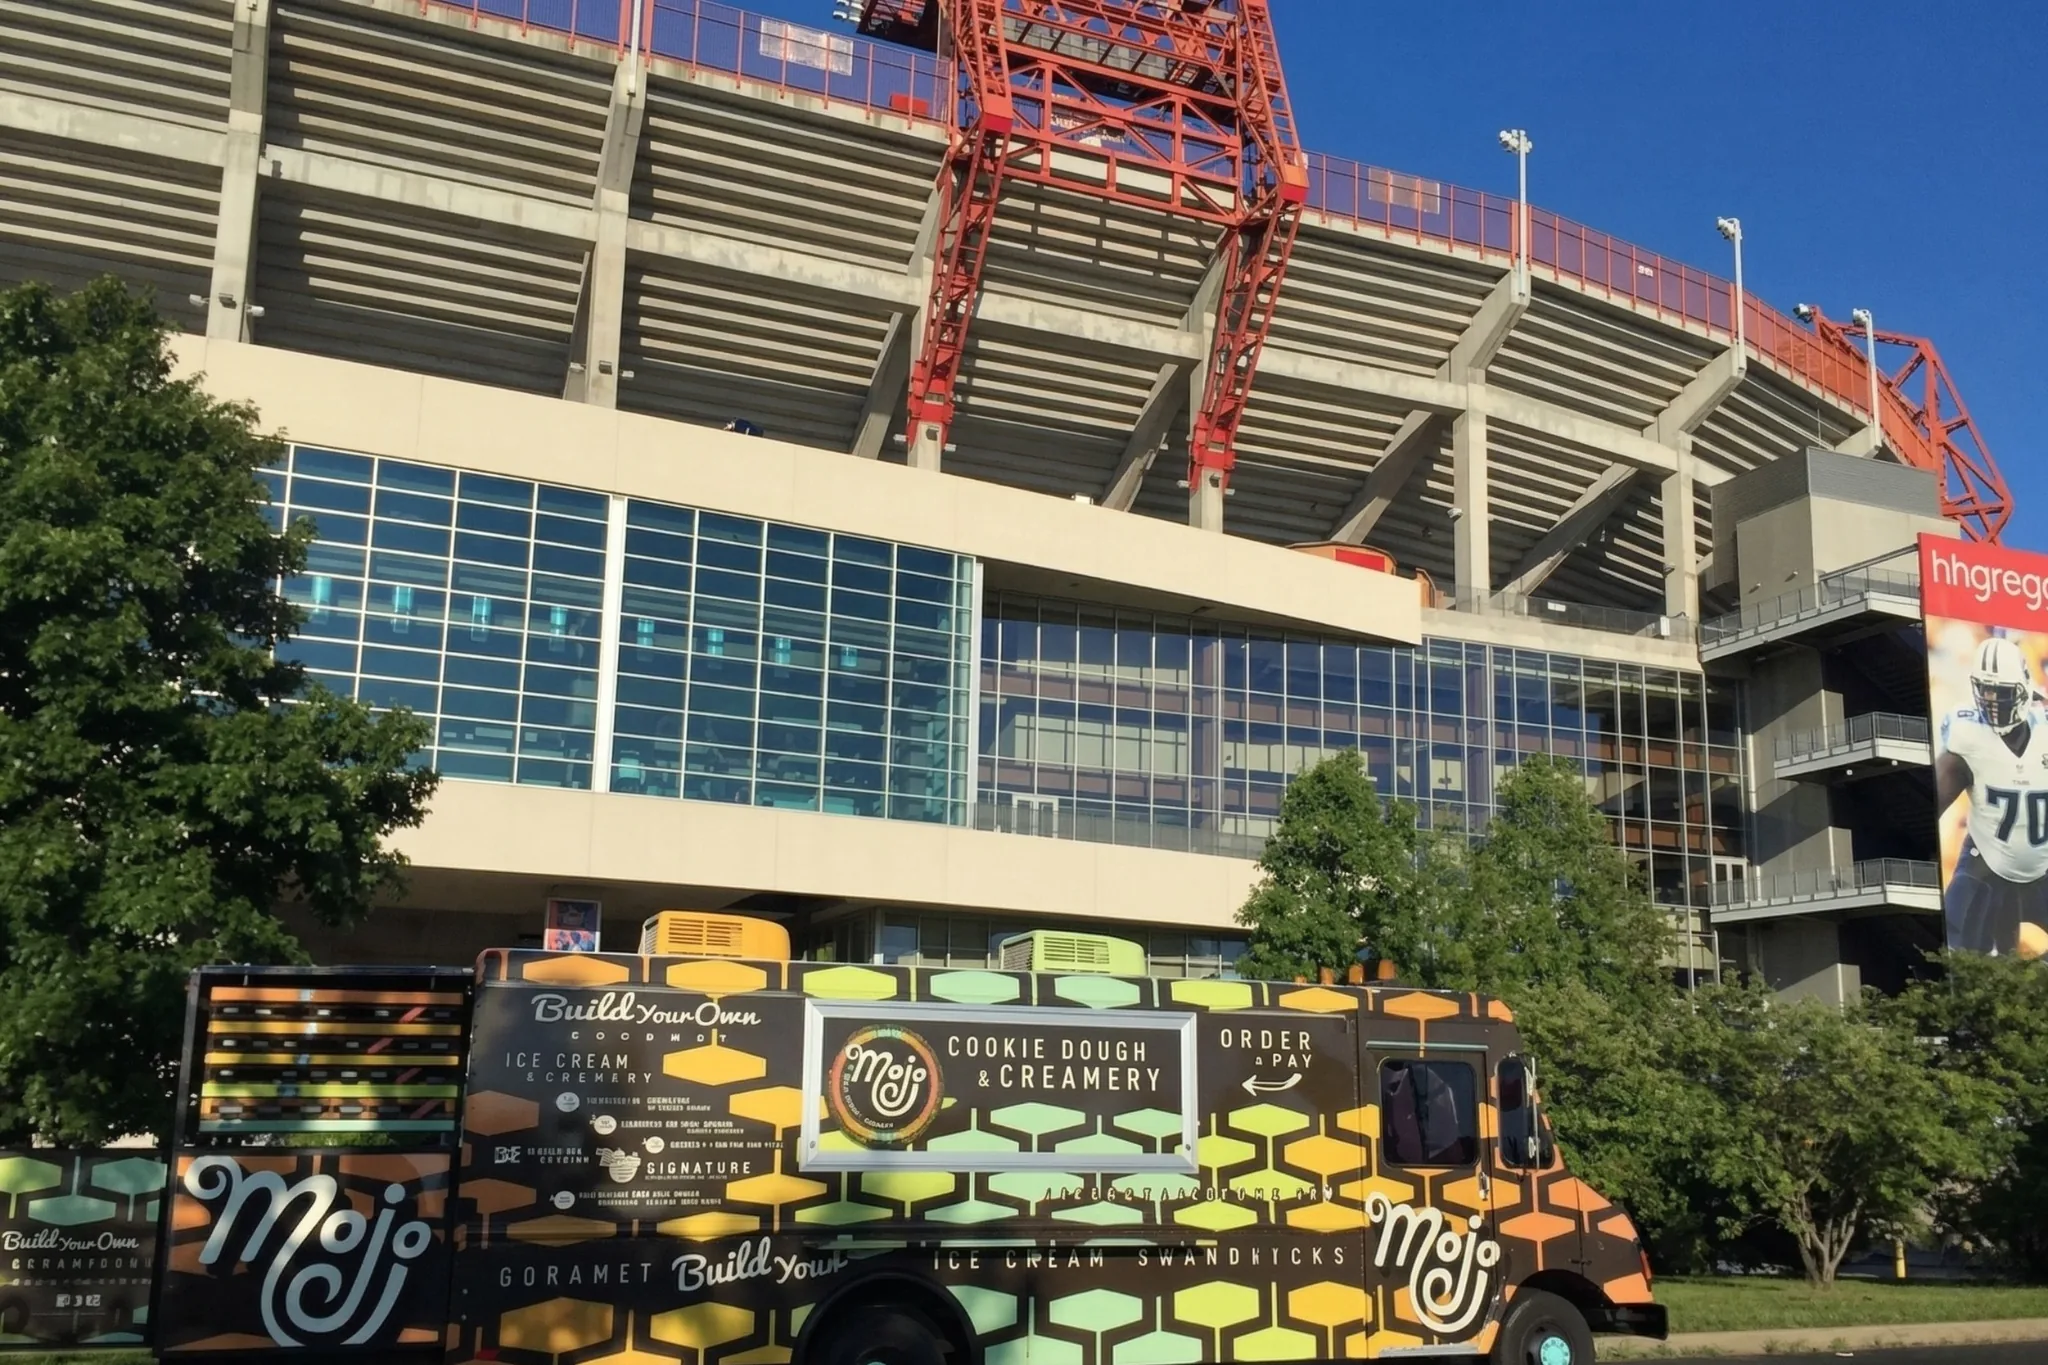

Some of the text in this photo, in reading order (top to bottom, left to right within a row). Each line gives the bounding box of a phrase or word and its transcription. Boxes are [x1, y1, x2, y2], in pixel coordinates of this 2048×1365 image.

[1985, 784, 2048, 848] 70
[531, 991, 761, 1027] Build Your Own
[947, 1035, 1147, 1063] COOKIE DOUGH
[1220, 1028, 1311, 1051] ORDER
[505, 1052, 629, 1070] ICE CREAM
[1272, 1053, 1312, 1069] PAY
[1000, 1064, 1161, 1092] CREAMERY
[646, 1161, 751, 1175] SIGNATURE
[2, 1228, 139, 1252] Build Your Own
[671, 1236, 773, 1292] Build
[934, 1250, 980, 1271] ICE
[1005, 1249, 1104, 1269] CREAM
[499, 1263, 652, 1288] GORAMET
